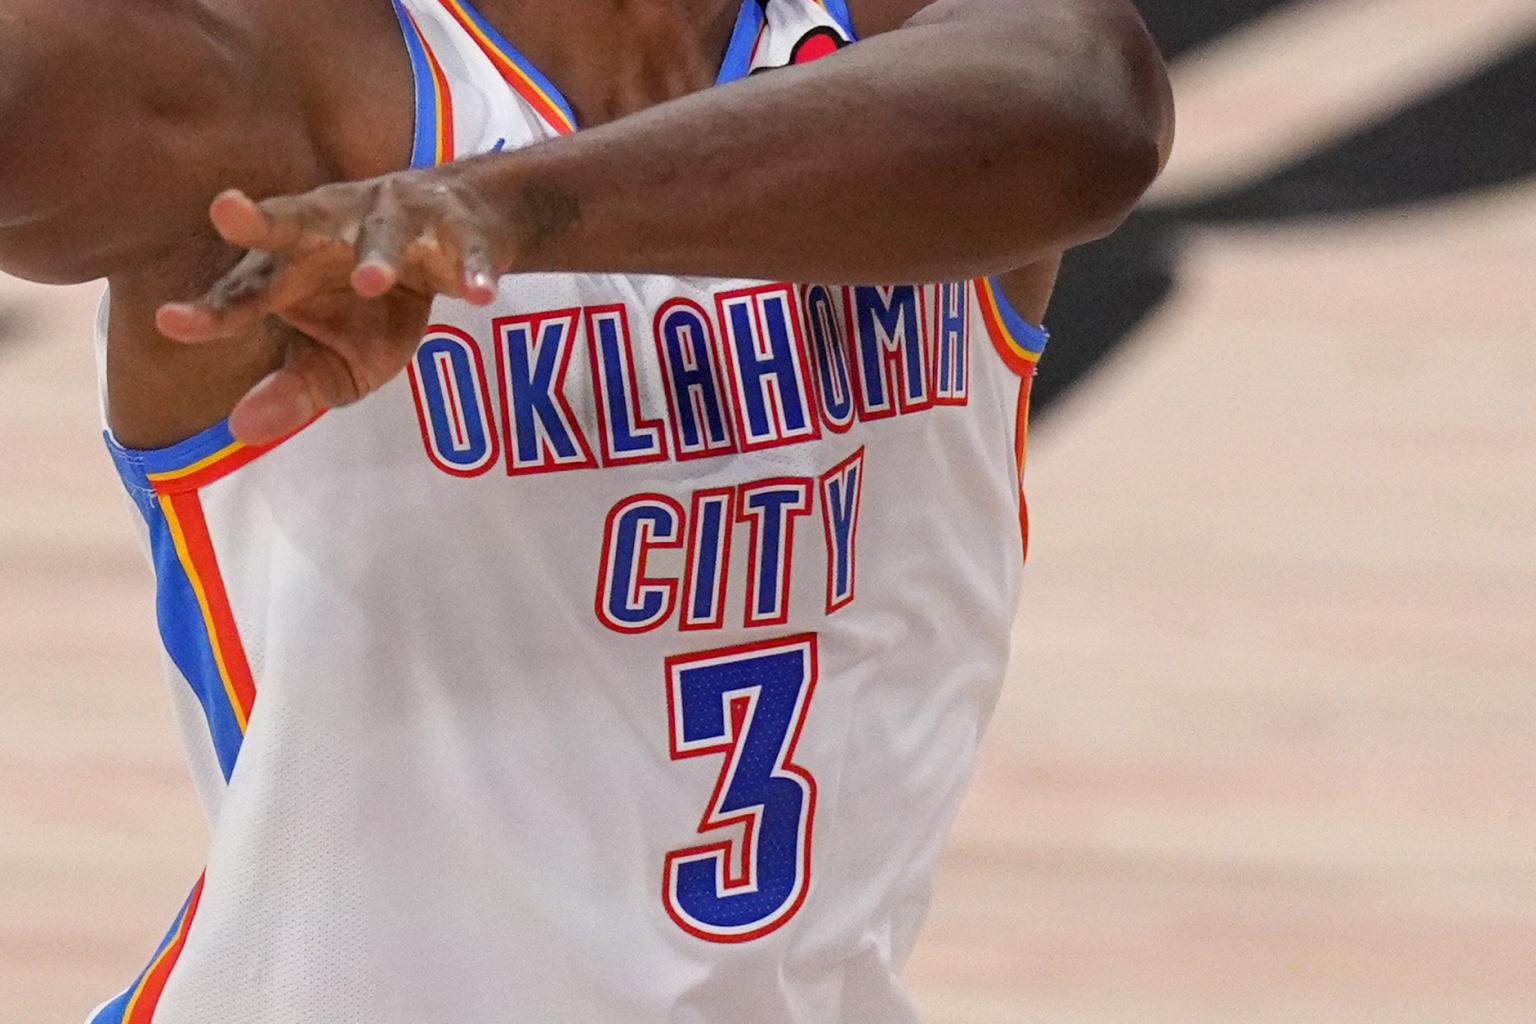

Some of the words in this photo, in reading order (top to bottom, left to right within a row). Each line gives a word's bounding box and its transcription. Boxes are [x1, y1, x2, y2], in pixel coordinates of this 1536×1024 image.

[408, 282, 969, 478] OKLAHOMA
[594, 445, 865, 634] CITY
[663, 632, 817, 943] 3
